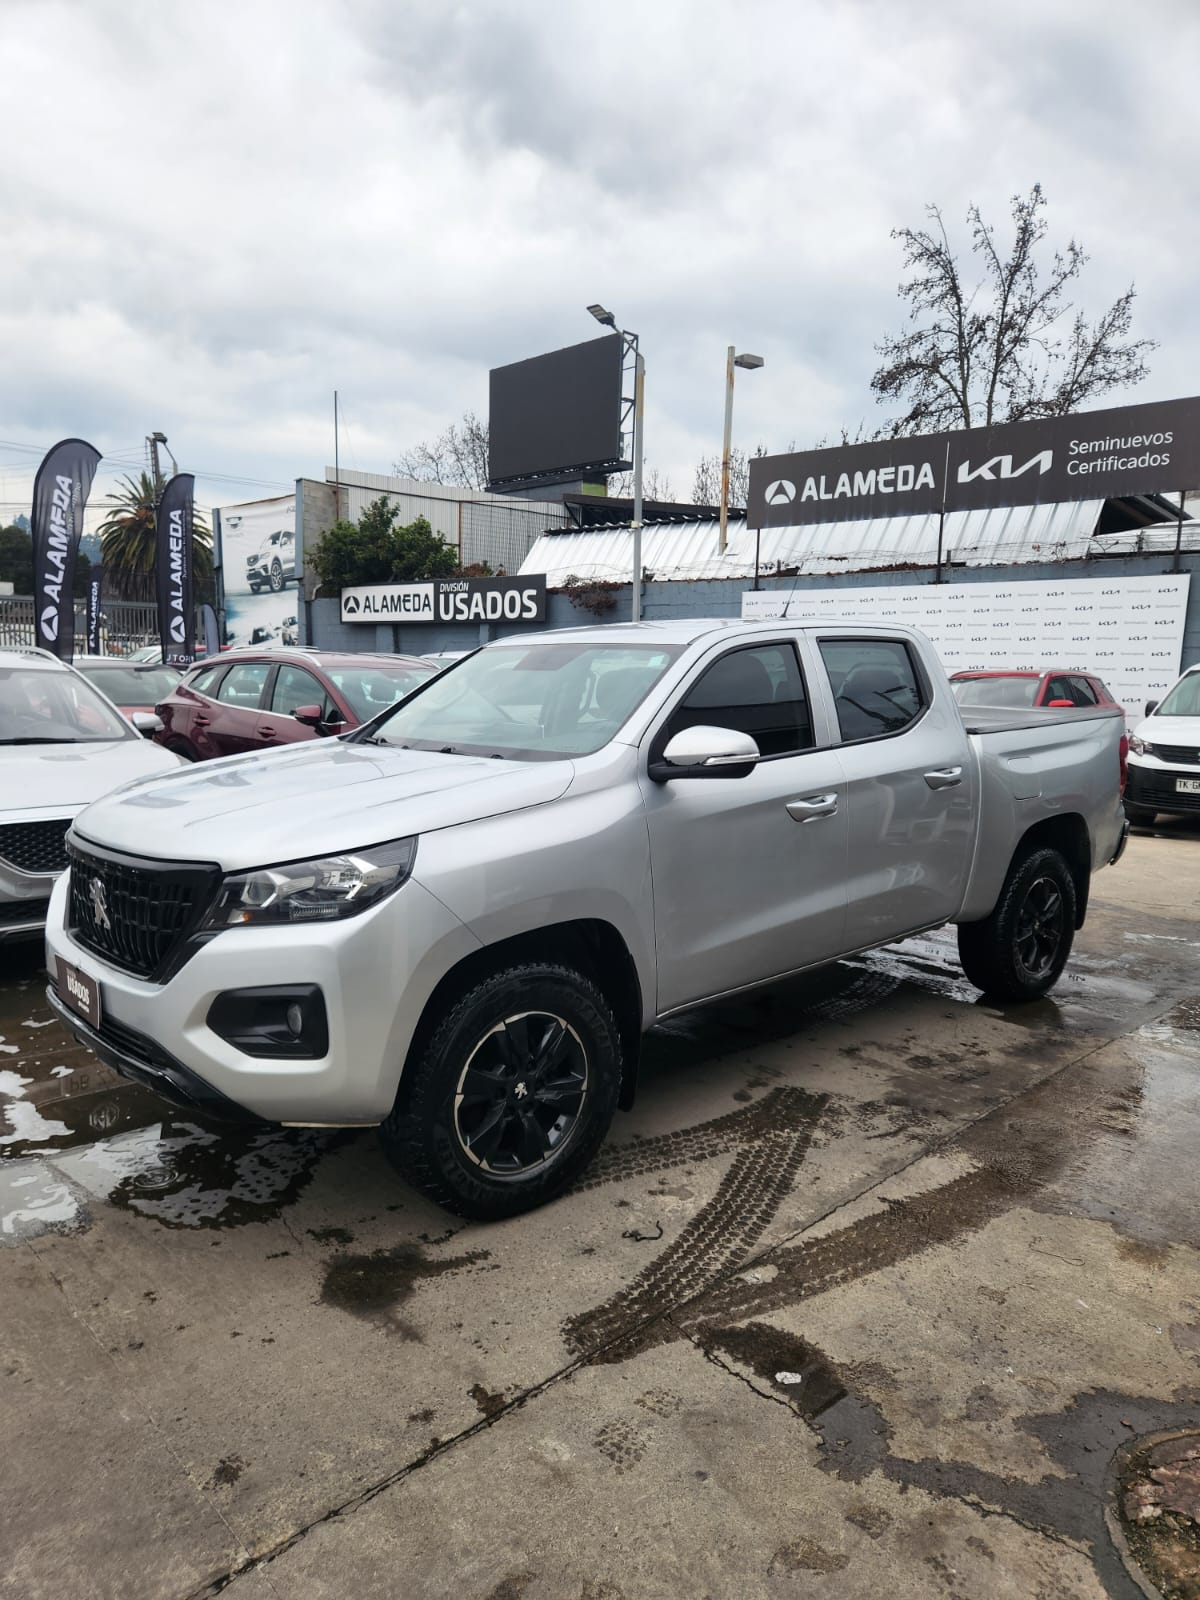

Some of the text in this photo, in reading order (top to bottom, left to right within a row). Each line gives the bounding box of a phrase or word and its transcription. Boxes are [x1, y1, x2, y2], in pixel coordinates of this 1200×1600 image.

[1068, 431, 1174, 456] Seminuevos
[1066, 451, 1171, 476] Certificados
[800, 462, 936, 503] ALAMEDA
[43, 474, 73, 604] ALAMEDA
[169, 509, 185, 612] ALAMEDA
[439, 580, 470, 593] DIVISIÓN
[363, 593, 432, 614] ALAMEDA
[439, 589, 538, 621] USADOS
[67, 975, 90, 1005] USADOS
